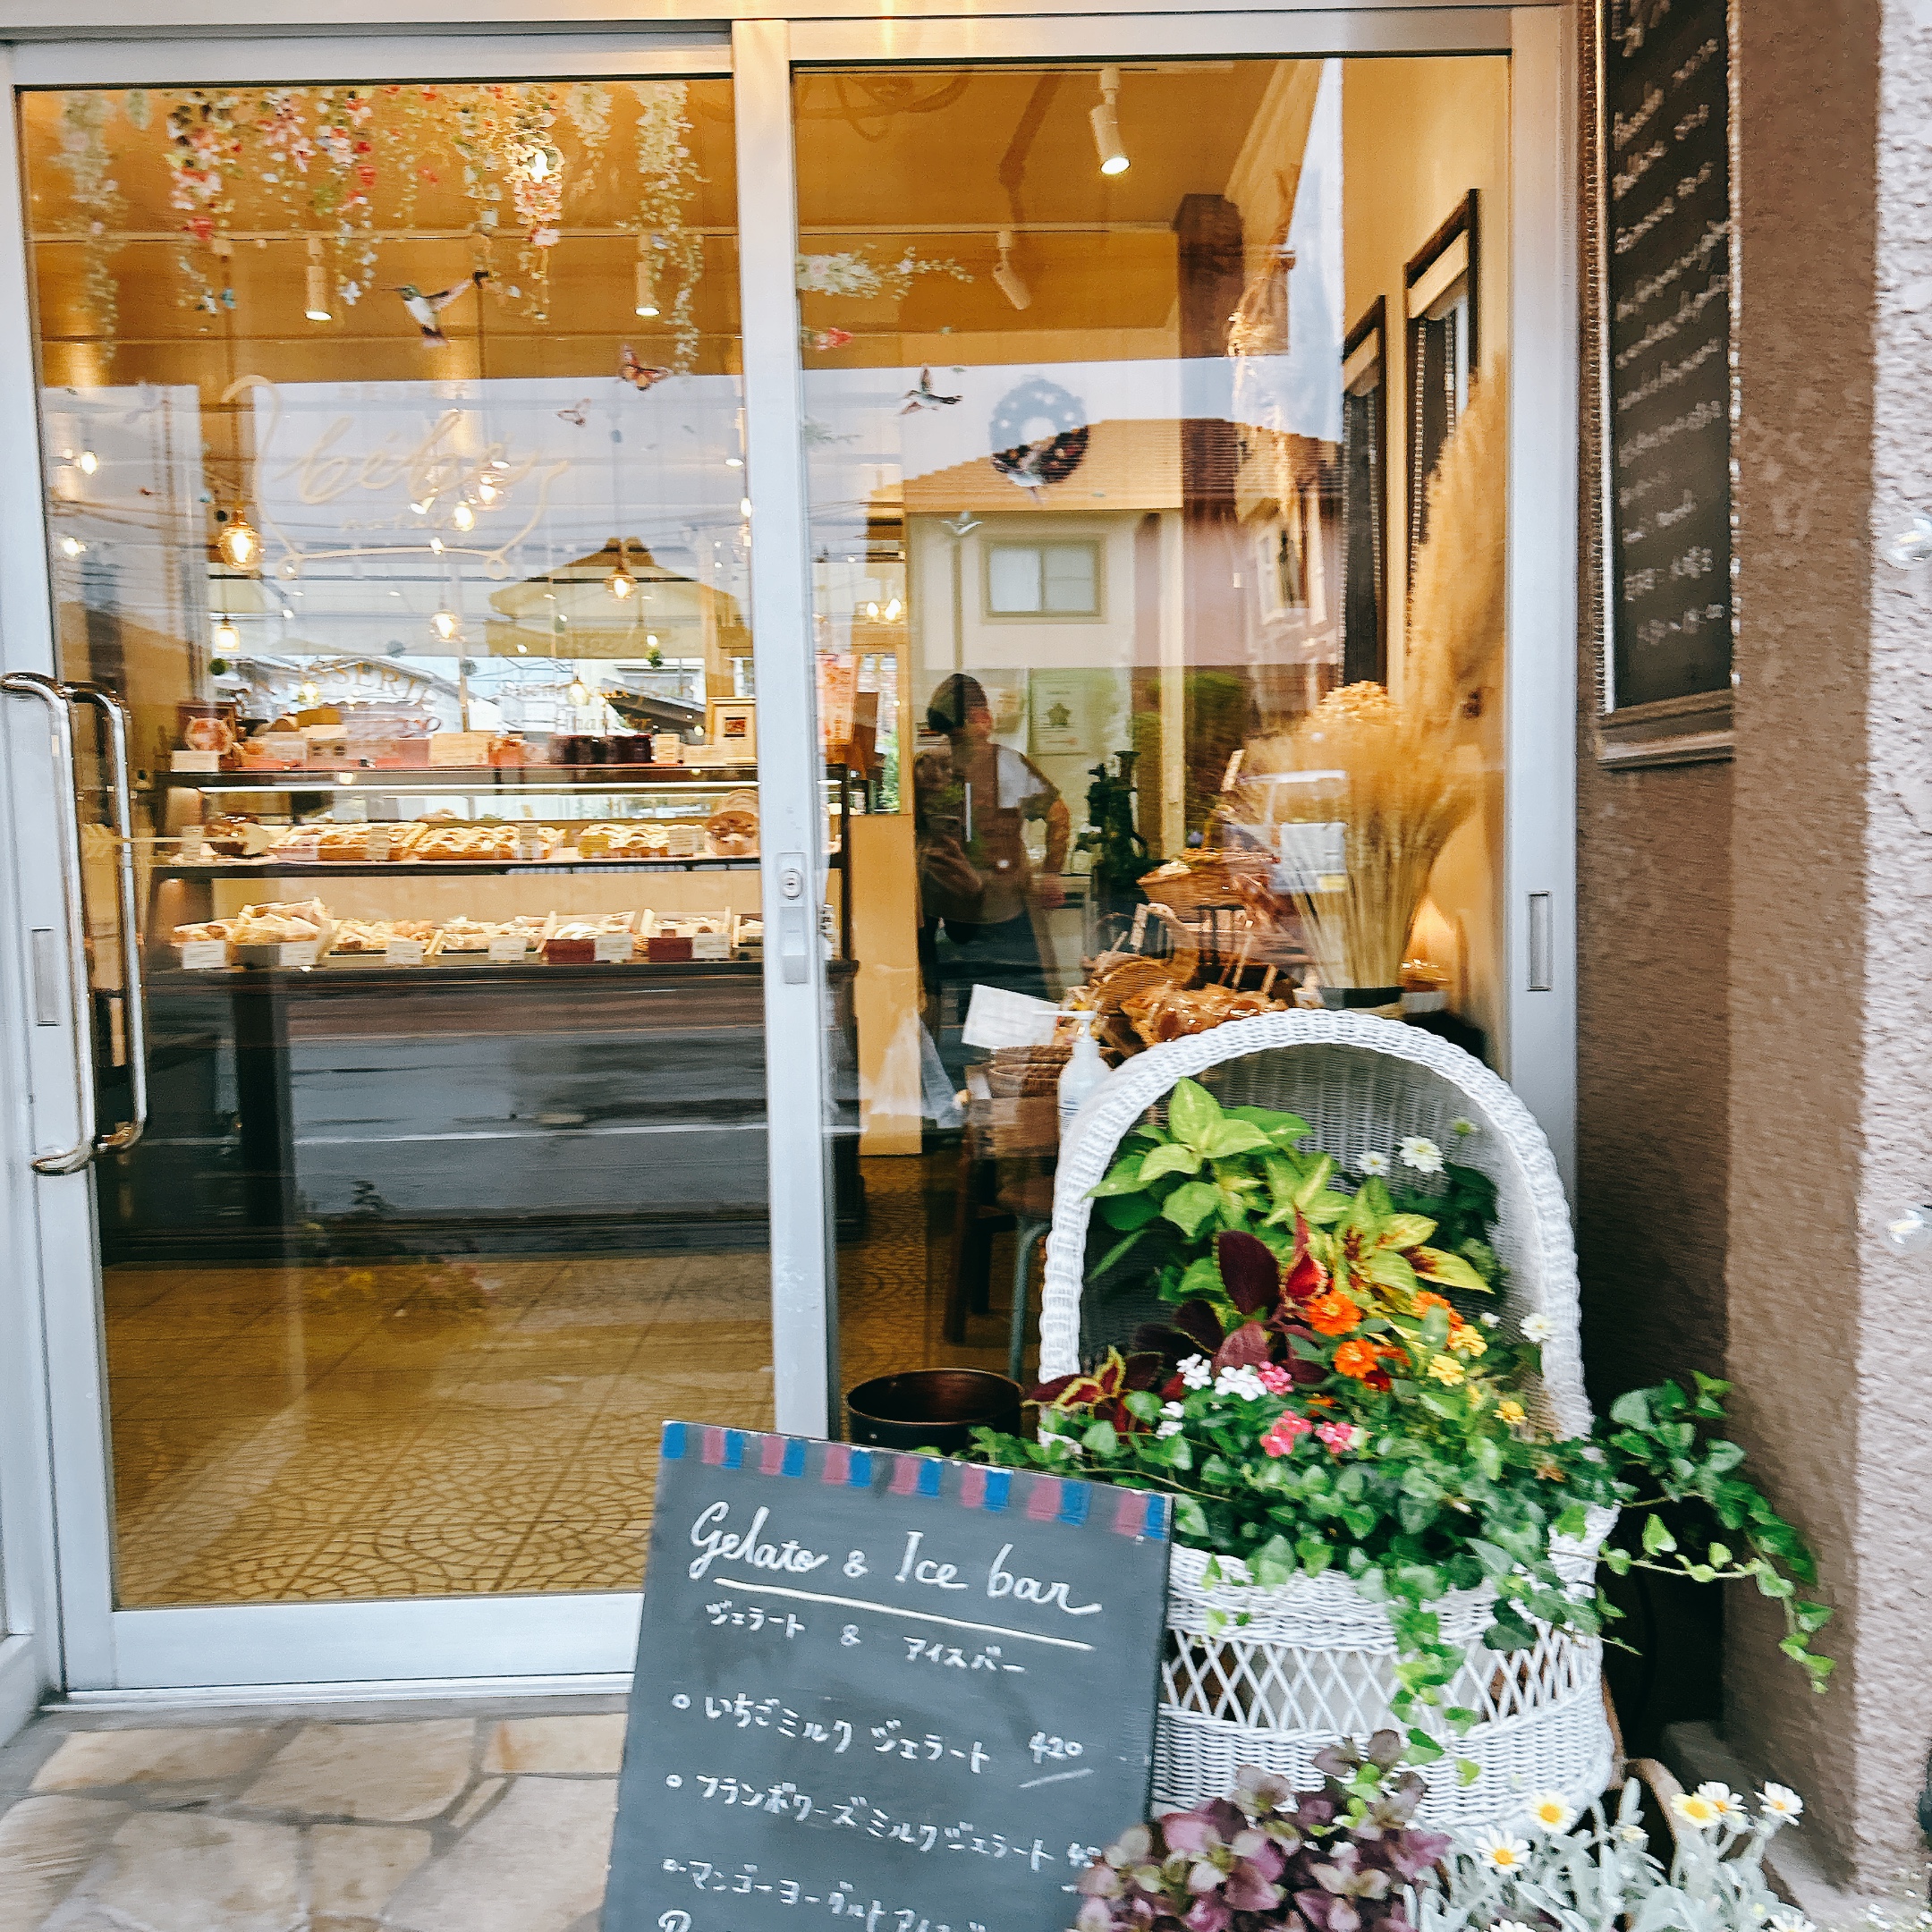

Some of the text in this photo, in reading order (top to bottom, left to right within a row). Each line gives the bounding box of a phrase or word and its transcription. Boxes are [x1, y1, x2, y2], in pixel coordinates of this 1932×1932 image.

[689, 1501, 1103, 1614] Gelato & Ice bar
[706, 1600, 1027, 1674] ジェラート & アイスバー
[1028, 1731, 1085, 1765] 420
